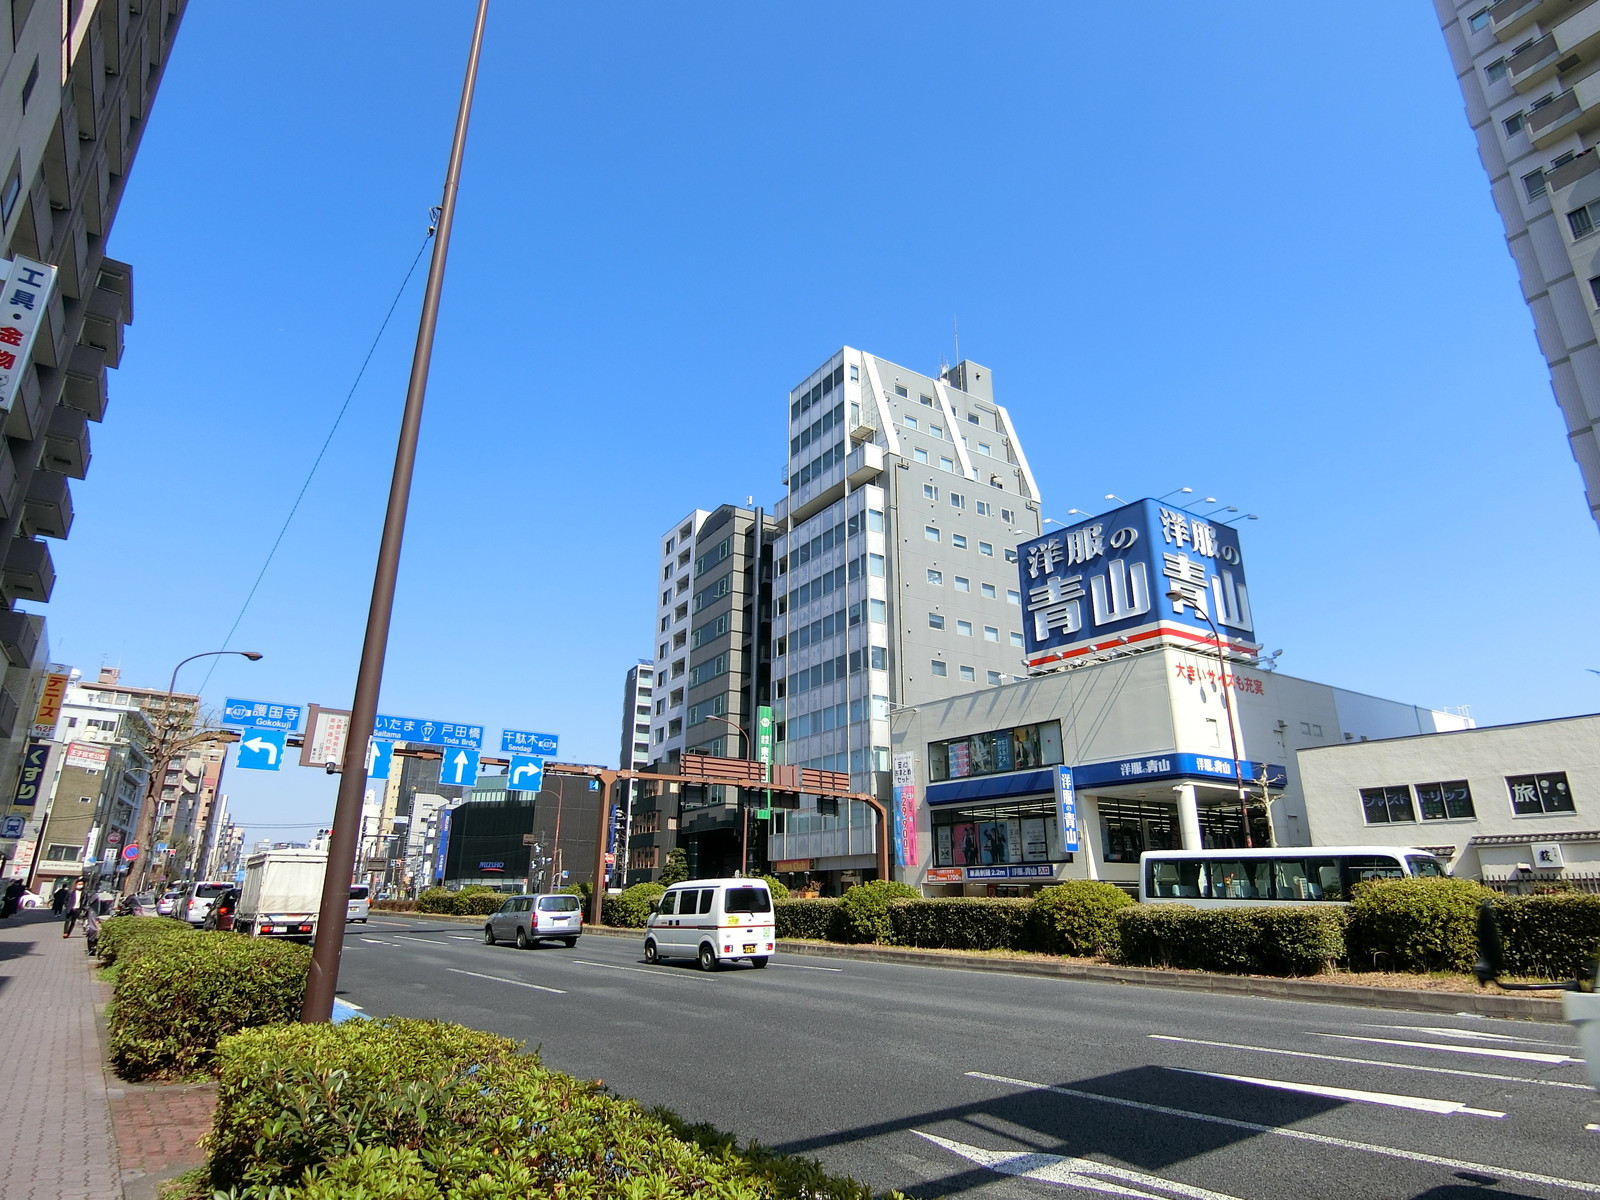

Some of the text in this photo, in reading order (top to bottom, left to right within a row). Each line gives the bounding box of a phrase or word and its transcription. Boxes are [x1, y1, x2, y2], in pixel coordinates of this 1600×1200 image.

[1159, 506, 1240, 566] 洋服の
[1027, 522, 1139, 578] 洋服の
[1027, 558, 1151, 642] 青山
[1162, 551, 1254, 632] 青山
[1175, 662, 1264, 696] 大きいサイズも充実
[40, 676, 67, 717] デニーズ
[232, 708, 245, 716] 437
[252, 703, 299, 721] 護国寺
[256, 717, 291, 729] Gokokuji
[423, 727, 431, 735] 17
[441, 723, 481, 739] 戸田橋
[373, 729, 401, 739] Saitama
[443, 736, 459, 744] Toda
[503, 731, 538, 746] 千駄木
[508, 743, 533, 753] Sendagi
[18, 749, 44, 799] くすり
[1120, 758, 1171, 776] 洋服の青山
[1196, 757, 1231, 775] 洋服の青山
[1363, 787, 1468, 807] ジャスト トリップ
[1511, 783, 1538, 803] 旅
[1061, 773, 1077, 844] 洋服の青山
[1038, 866, 1049, 874] 入口
